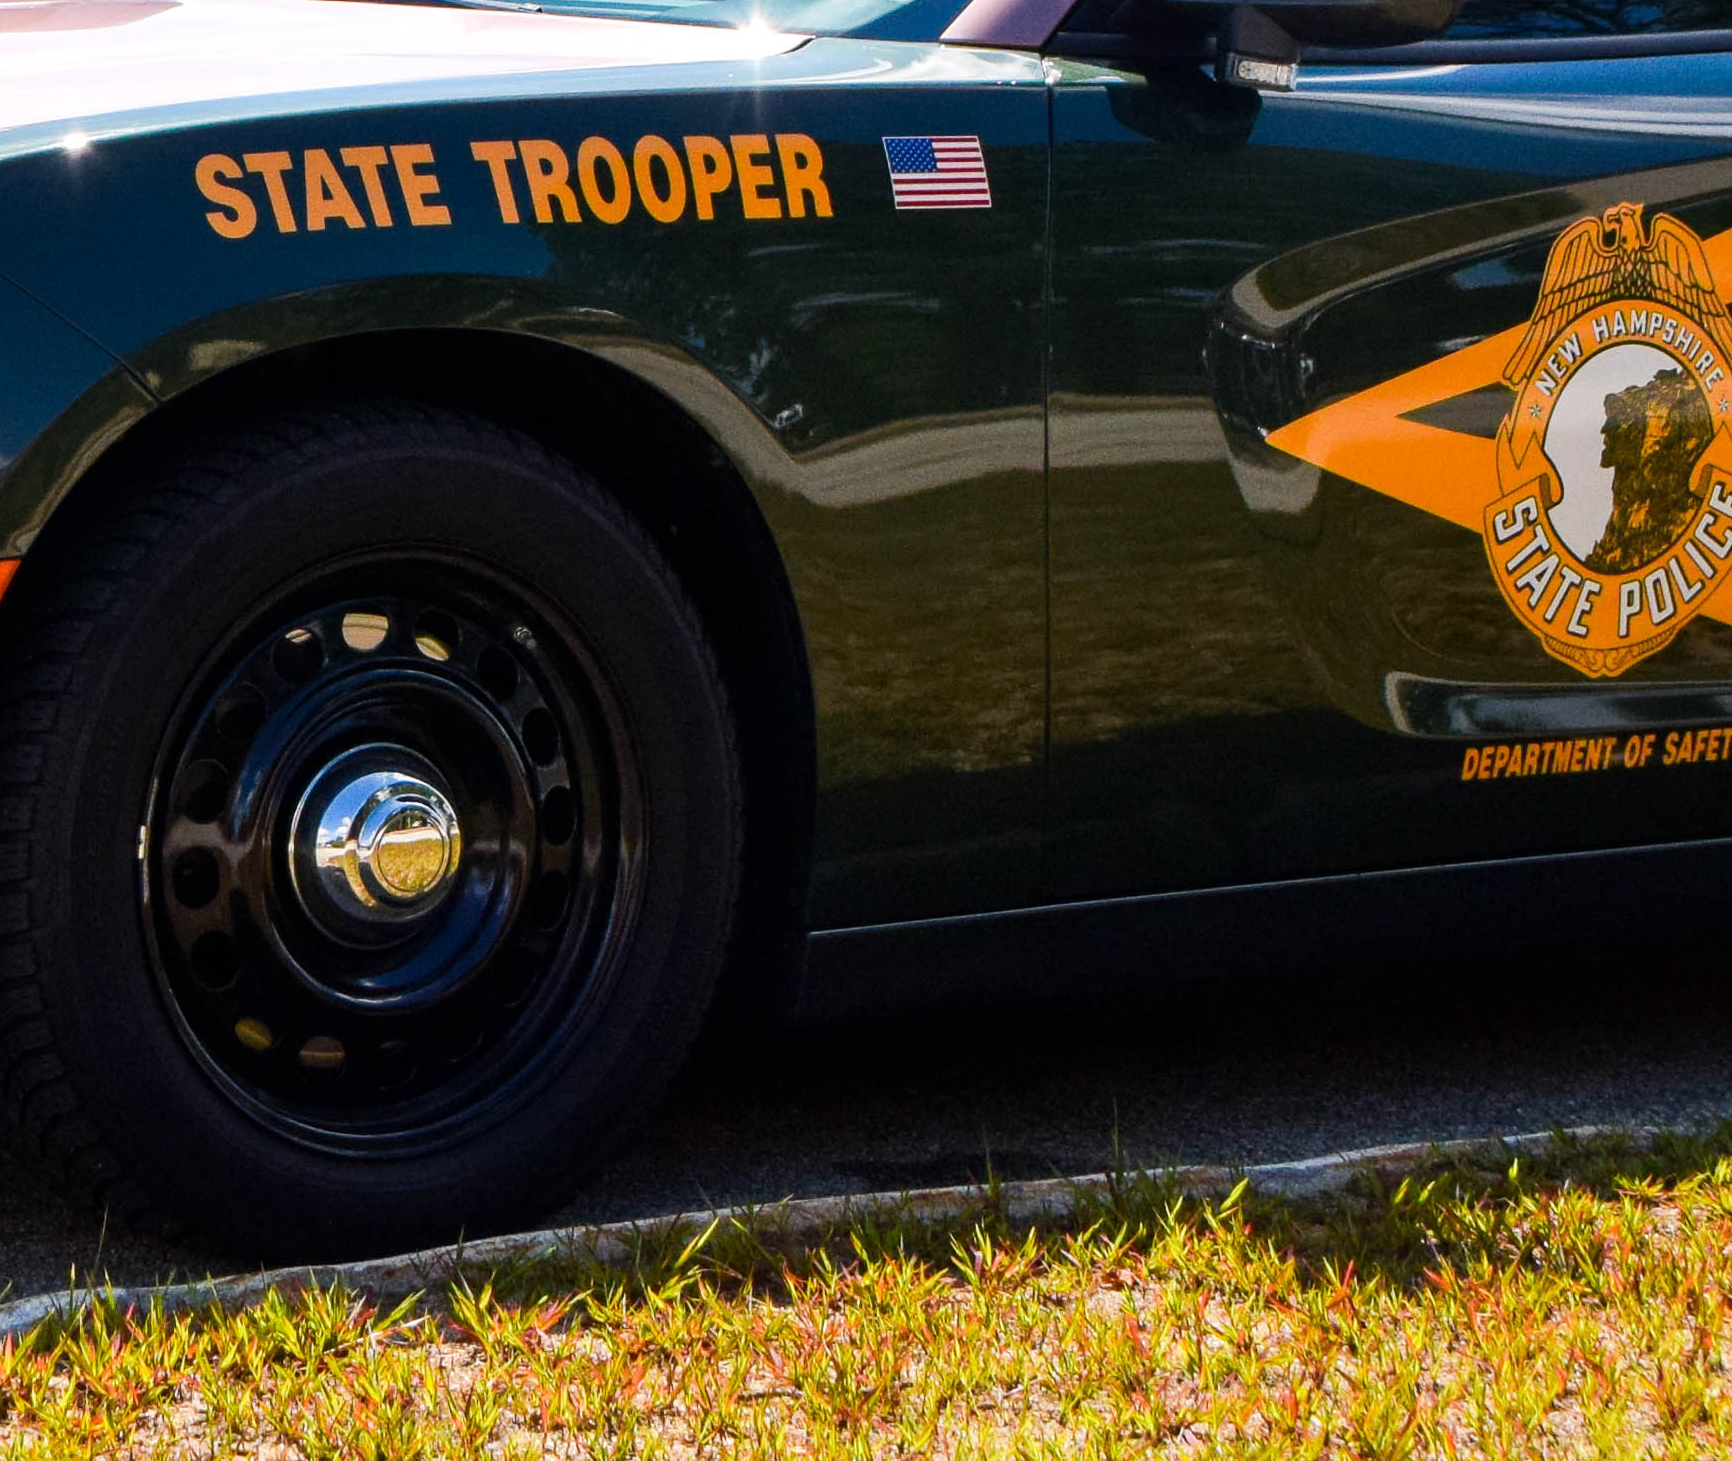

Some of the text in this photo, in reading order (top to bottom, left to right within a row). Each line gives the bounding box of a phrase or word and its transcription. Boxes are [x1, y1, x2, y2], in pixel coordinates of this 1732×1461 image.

[195, 134, 834, 239] STATE TROOPER
[1534, 309, 1725, 398] NEW HAMPSHIRE
[1492, 495, 1601, 638] STATE
[1460, 736, 1618, 781] DEPARTMENT
[1623, 734, 1657, 769] OF
